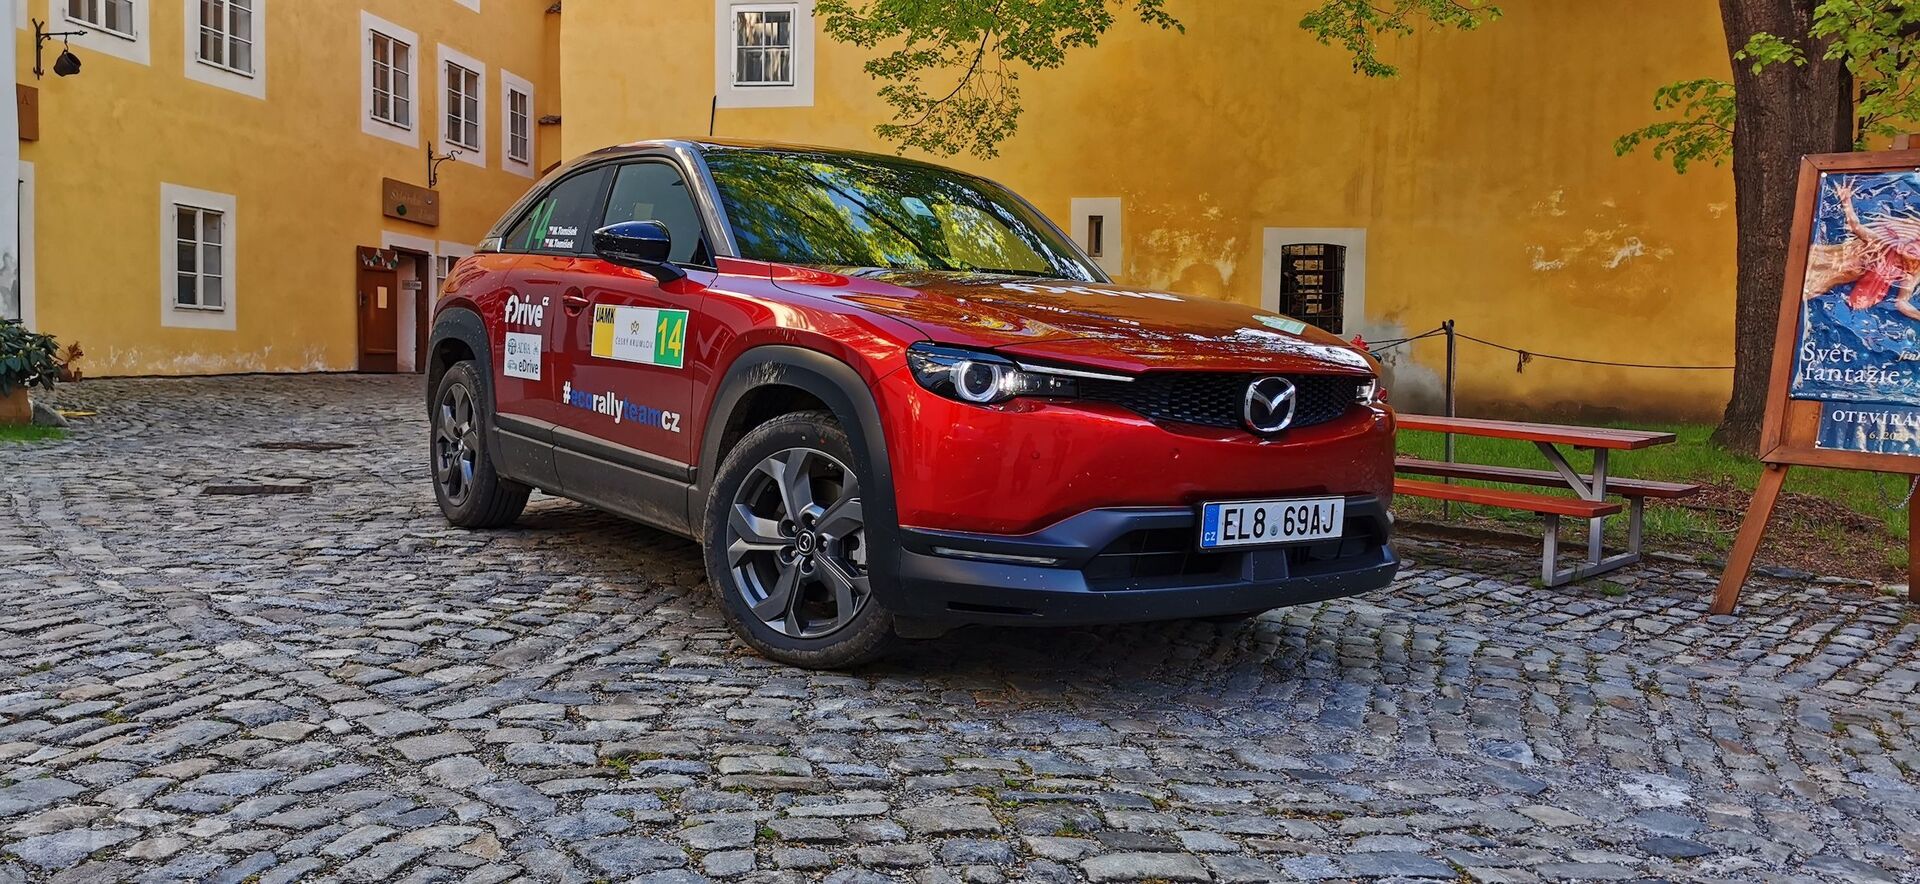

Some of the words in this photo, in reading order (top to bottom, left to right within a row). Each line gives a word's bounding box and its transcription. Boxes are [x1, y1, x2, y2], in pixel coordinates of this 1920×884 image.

[525, 198, 558, 249] 14
[658, 317, 682, 358] 14
[1802, 341, 1854, 363] Svět
[518, 359, 539, 374] eDrive
[1804, 360, 1900, 385] fantazie
[563, 381, 681, 433] #ecorallyteamcz
[1204, 531, 1216, 541] CZ
[1223, 507, 1266, 541] EL8
[1283, 503, 1335, 537] 69AJ
